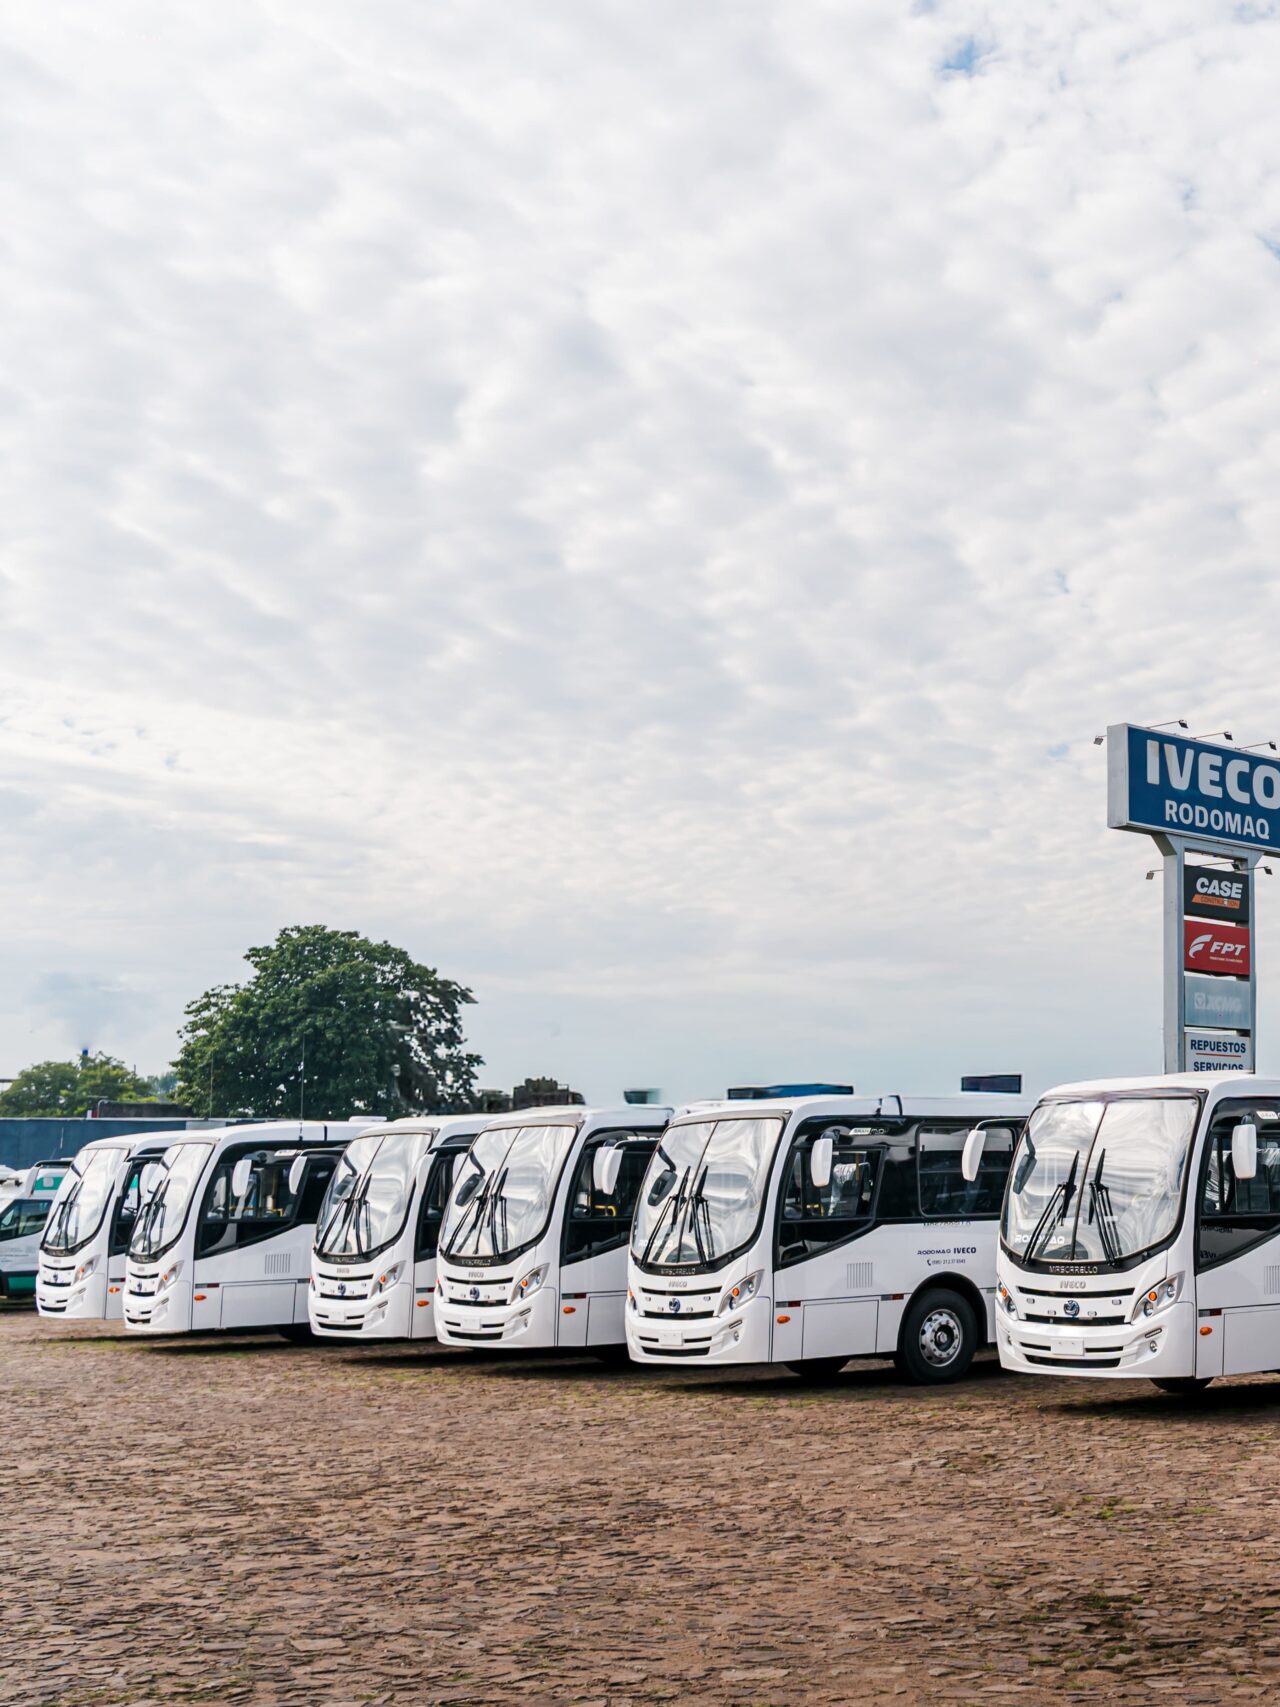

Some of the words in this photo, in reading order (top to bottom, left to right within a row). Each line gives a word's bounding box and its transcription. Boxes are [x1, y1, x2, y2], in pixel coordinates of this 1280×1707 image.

[1165, 799, 1270, 840] RODOMAQ
[1196, 877, 1243, 898] CASE
[1209, 941, 1246, 956] FPT
[1190, 1039, 1246, 1054] REPUESTOS
[1193, 1061, 1244, 1071] SERVICIOS
[917, 1248, 951, 1256] RODOMAQ
[953, 1246, 977, 1255] IVECO
[1049, 1265, 1098, 1274] MASCARELLO
[1060, 1280, 1087, 1289] IVECO
